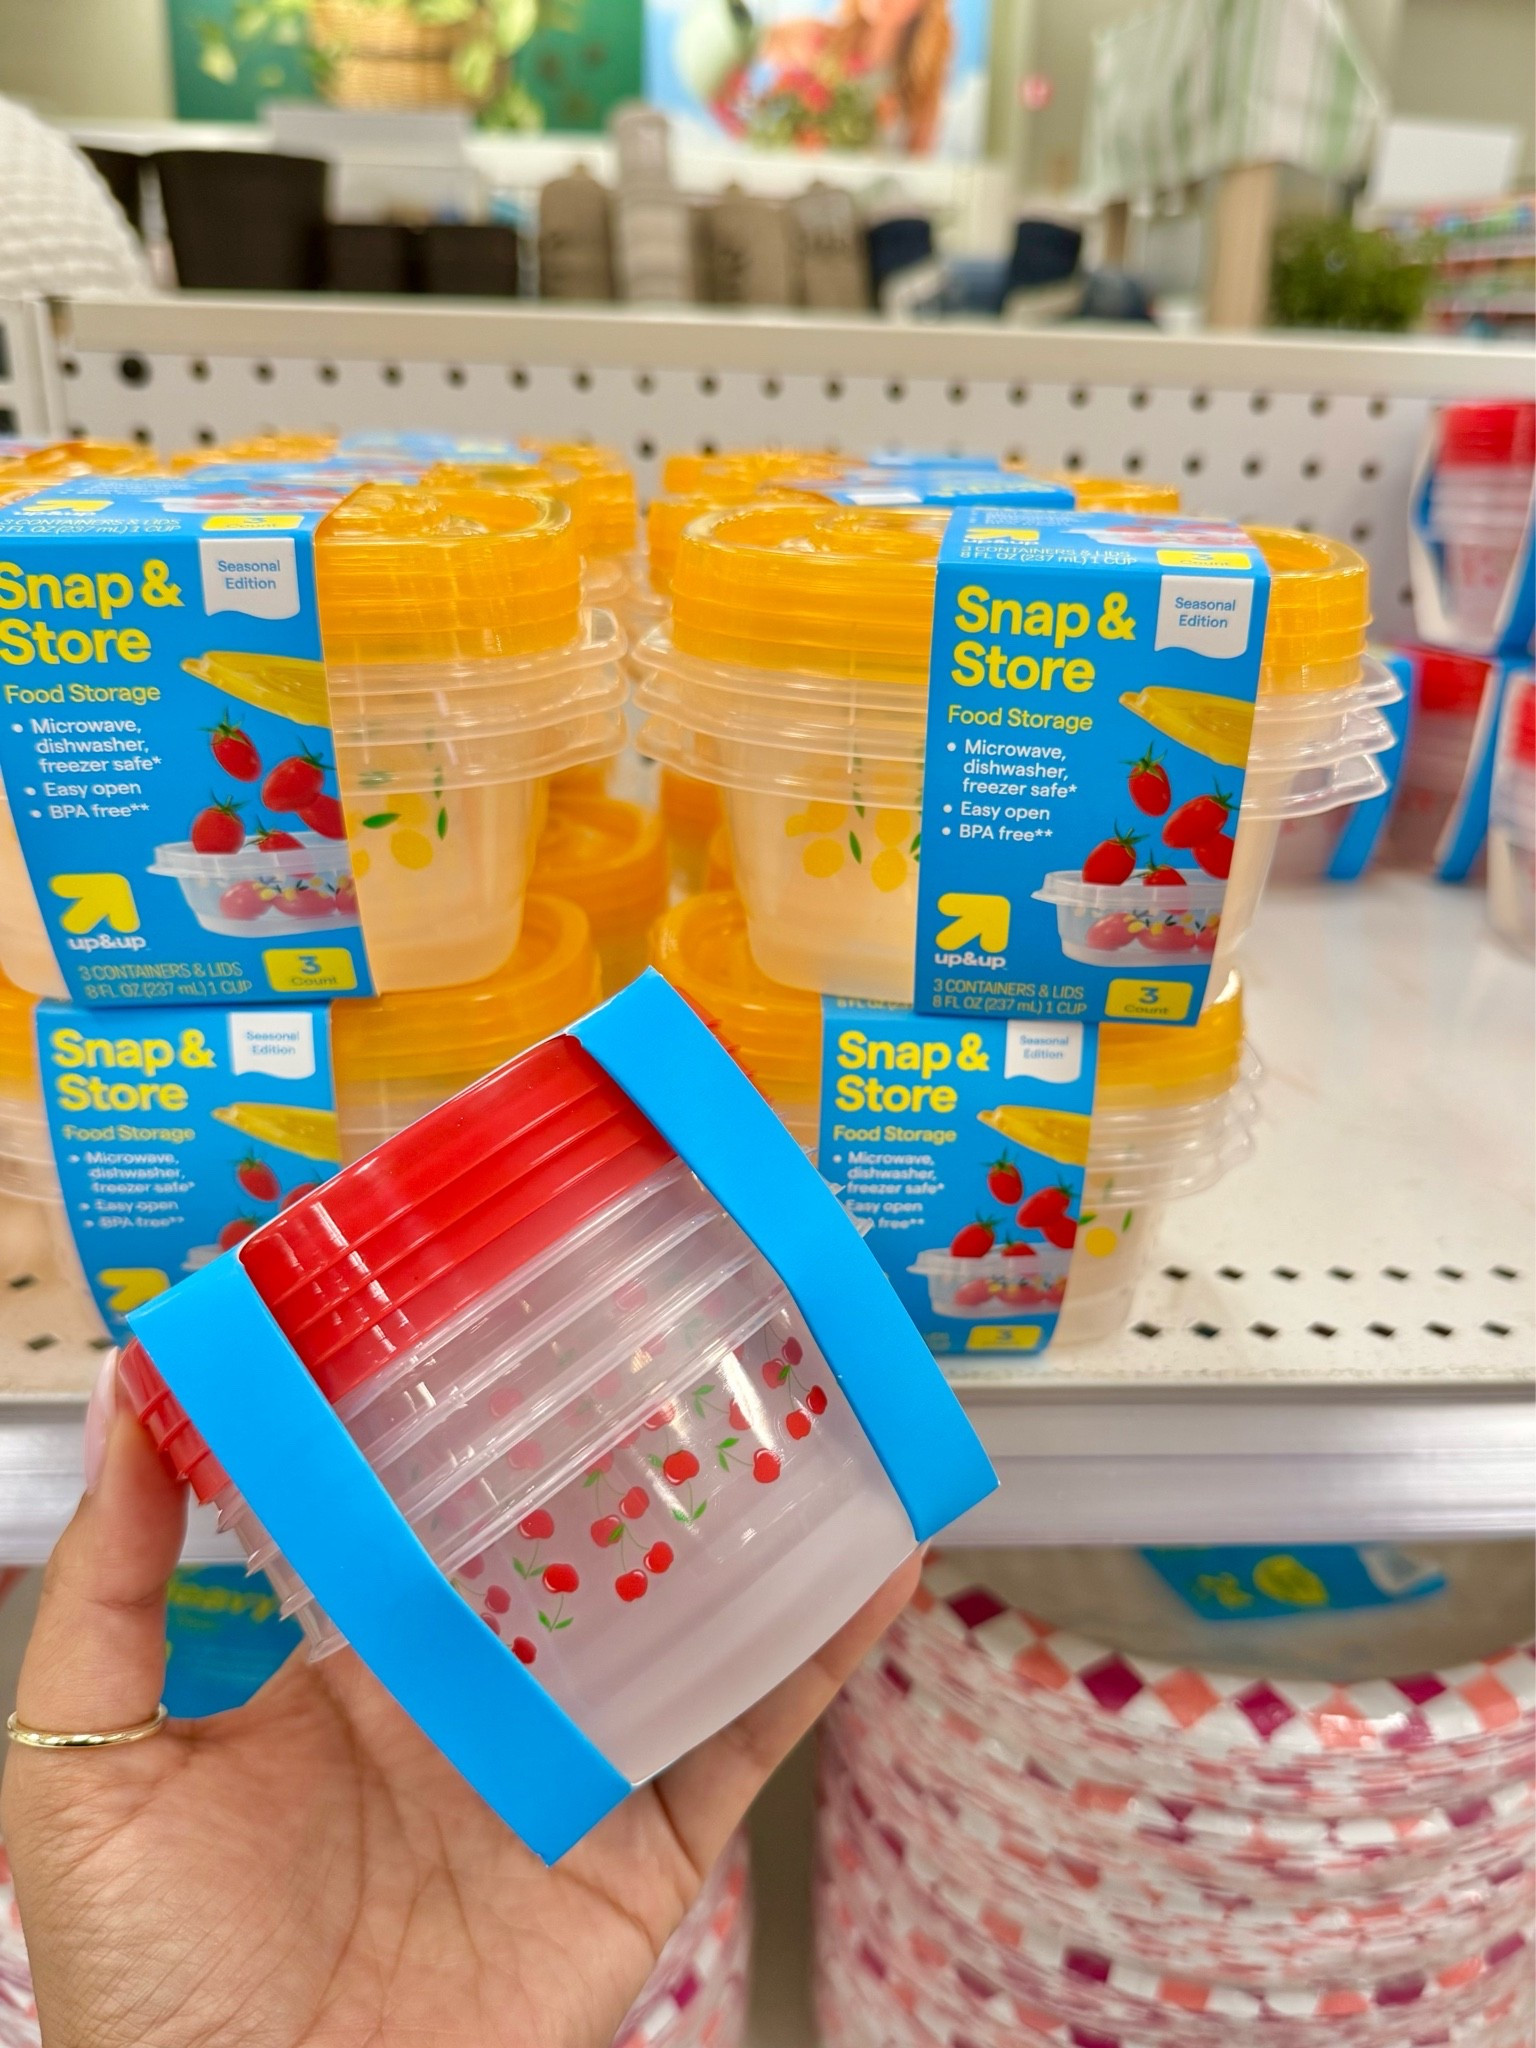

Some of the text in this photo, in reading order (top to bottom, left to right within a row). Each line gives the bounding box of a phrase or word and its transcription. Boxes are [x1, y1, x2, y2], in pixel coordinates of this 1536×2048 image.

[217, 560, 281, 573] Seasonal
[0, 559, 186, 620] Snap &
[225, 577, 277, 590] Edition
[1175, 597, 1236, 611] Seasonal
[954, 585, 1136, 649] Snap &
[1179, 614, 1228, 628] Edition
[0, 618, 152, 666] Store
[951, 640, 1096, 693] Store
[4, 683, 161, 706] Food Storage
[30, 718, 142, 734] Microwave,
[948, 704, 1093, 734] Food Storage
[35, 737, 149, 755] dishwasher,
[964, 739, 1067, 761] Microwave,
[39, 758, 109, 774] freezer
[963, 759, 1068, 781] dishwasher,
[43, 781, 142, 799] Easy open
[962, 778, 1027, 796] freezer
[49, 804, 90, 820] BPA
[960, 801, 1050, 822] Easy open
[959, 824, 994, 840] BPA
[67, 934, 147, 953] up&up
[298, 955, 321, 975] 3
[934, 951, 1006, 970] up&up
[78, 961, 244, 982] 3 CONTAINERS & LIDS
[291, 976, 337, 986] Count
[119, 983, 141, 998] OZ
[142, 981, 174, 999] (237
[220, 980, 253, 995] CUP
[933, 979, 1084, 999] 3 CONTAINERS & LIDS
[1140, 987, 1159, 1004] 3
[932, 996, 942, 1008] 8
[944, 996, 961, 1009] FL
[963, 997, 982, 1010] OZ
[984, 998, 1016, 1013] (237
[1046, 1002, 1054, 1013] 1
[1056, 1002, 1088, 1015] CUP
[1124, 1005, 1169, 1016] Count
[245, 1030, 301, 1042] Seasonal
[1019, 1035, 1069, 1046] Seasonal
[51, 1028, 217, 1077] Snap &
[251, 1045, 296, 1056] Edition
[837, 1030, 990, 1079] Snap &
[1023, 1049, 1064, 1060] Edition
[56, 1073, 189, 1111] Store
[836, 1074, 958, 1113] Store
[62, 1124, 196, 1144] Food Storage
[833, 1125, 957, 1146] Food Storage
[883, 1203, 923, 1213] open
